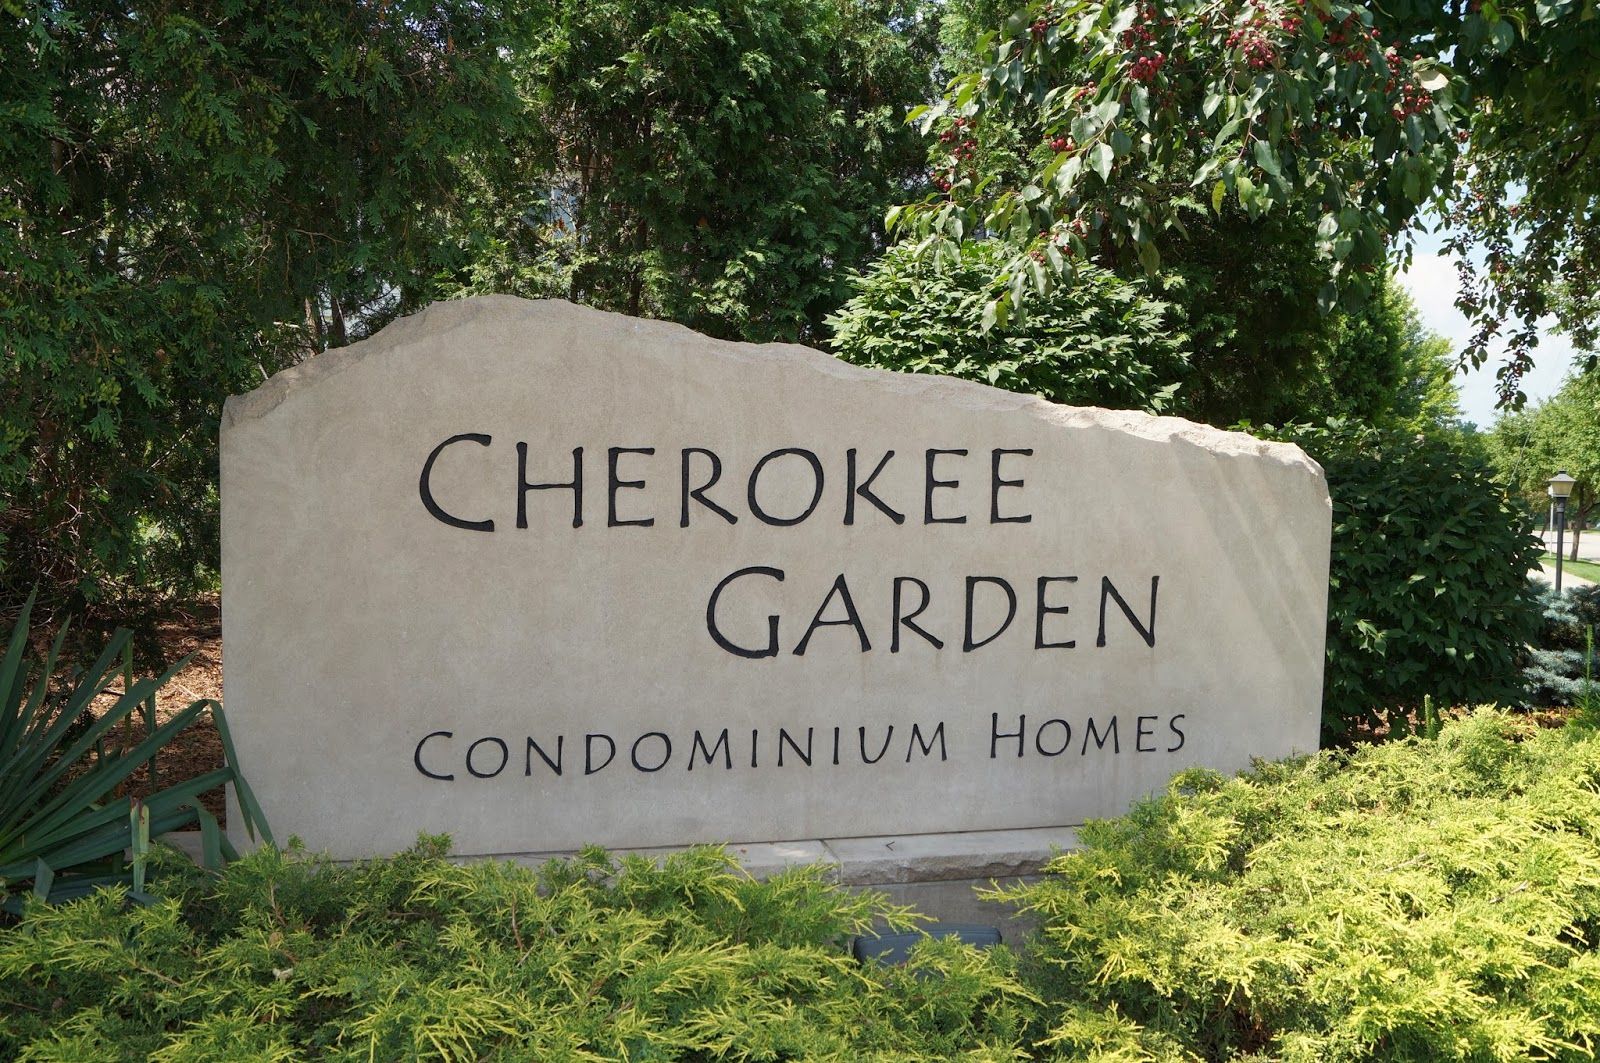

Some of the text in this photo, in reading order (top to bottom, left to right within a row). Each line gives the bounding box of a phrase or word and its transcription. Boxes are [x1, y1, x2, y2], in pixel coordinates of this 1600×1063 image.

[418, 432, 1034, 533] CHEROKEE
[706, 565, 1160, 660] GARDEN
[413, 712, 1186, 782] CONDOMINIUM HOMES
